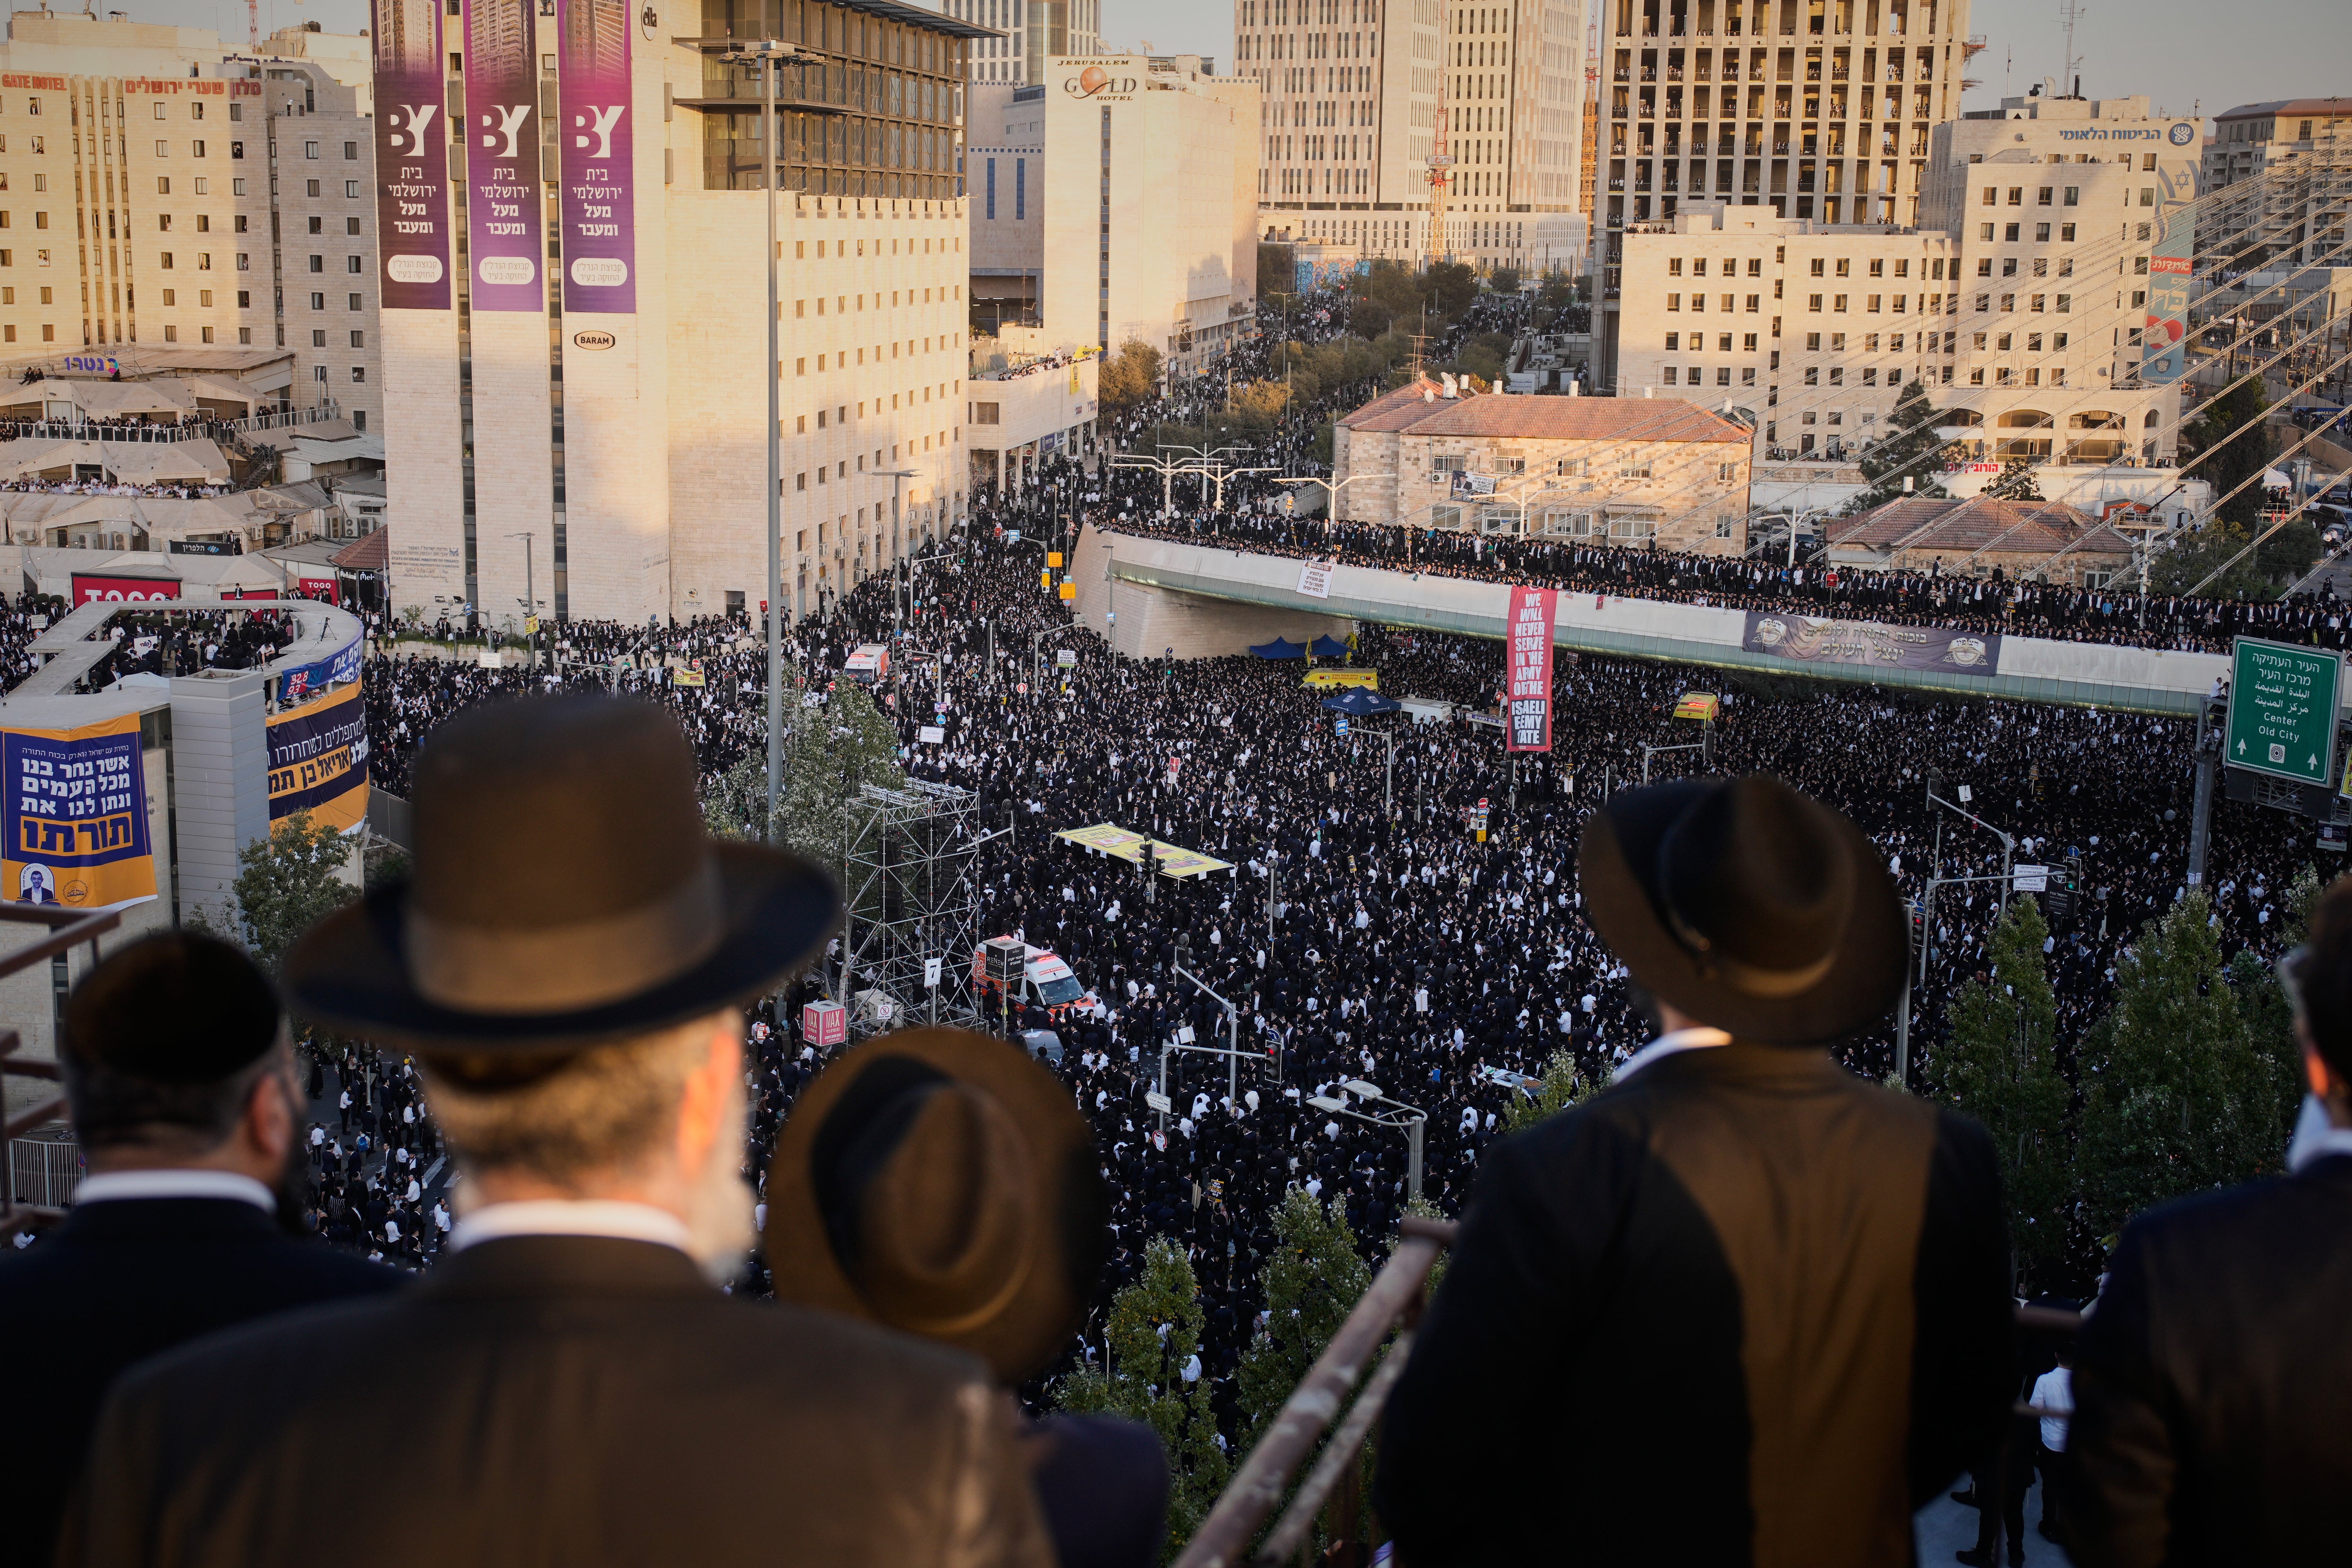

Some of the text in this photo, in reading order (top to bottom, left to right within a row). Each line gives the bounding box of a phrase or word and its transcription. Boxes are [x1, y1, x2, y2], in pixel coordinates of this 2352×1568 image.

[643, 7, 657, 27] ella
[2, 74, 67, 91] GATE HOTEL
[125, 76, 261, 99] מלון שערי ירושלים
[390, 105, 438, 156] BY
[482, 105, 531, 157] BY
[576, 106, 625, 158] BY
[2060, 127, 2161, 140] הביטוח הלאומי
[401, 167, 423, 179] בית
[493, 168, 515, 180] בית
[586, 169, 608, 181] בית
[388, 183, 436, 197] ירושלמי
[480, 184, 529, 198] ירושלמי
[572, 185, 622, 199] ירושלמי
[399, 200, 426, 215] מעל
[492, 202, 518, 217] מעל
[584, 203, 611, 218] מעל
[394, 221, 433, 233] ומעבר
[486, 222, 526, 235] ומעבר
[578, 223, 618, 236] ומעבר
[416, 261, 437, 270] קבוצת
[508, 263, 529, 271] קבוצת
[601, 264, 622, 273] קבוצת
[414, 271, 434, 280] החזקה
[506, 273, 526, 281] החזקה
[598, 275, 619, 283] החזקה
[183, 544, 204, 552] הלפרין
[1525, 593, 1541, 607] WE
[1520, 607, 1543, 622] WILL
[1515, 621, 1545, 637] NEVER
[1853, 626, 1888, 639] התורה
[1515, 636, 1544, 652] SERVE
[1895, 632, 1927, 644] בזכות
[1820, 637, 1865, 657] העולם
[332, 651, 347, 674] את
[1515, 651, 1543, 666] IN THE
[2253, 653, 2320, 673] העיר העתיקה
[291, 670, 308, 686] 92.8
[1516, 666, 1542, 681] ARMY
[2259, 668, 2311, 686] מרכז העיר
[287, 684, 301, 695] 93
[1527, 680, 1543, 695] THE
[2255, 681, 2310, 699] البلدة القديمة
[1512, 700, 1545, 715] ISAELI
[2255, 695, 2309, 715] مركز المدينة
[2264, 712, 2297, 726] Center
[2259, 726, 2300, 743] Old City
[22, 747, 46, 756] התורה
[49, 751, 66, 759] בכוח
[89, 748, 104, 756] ישראל
[114, 745, 129, 753] בחירת
[275, 733, 322, 764] לשחרורו
[22, 758, 54, 776] בנו
[96, 755, 129, 773] אשר
[316, 748, 349, 779] אריאל
[300, 764, 316, 789] בן
[22, 773, 130, 799] מכל העמים
[20, 797, 57, 815] את
[68, 797, 95, 816] לנו
[101, 793, 131, 814] ונתן
[24, 816, 130, 852] תורתו
[987, 956, 1004, 966] RENEW
[930, 965, 937, 978] 7
[807, 1009, 840, 1029] MAX MAX
